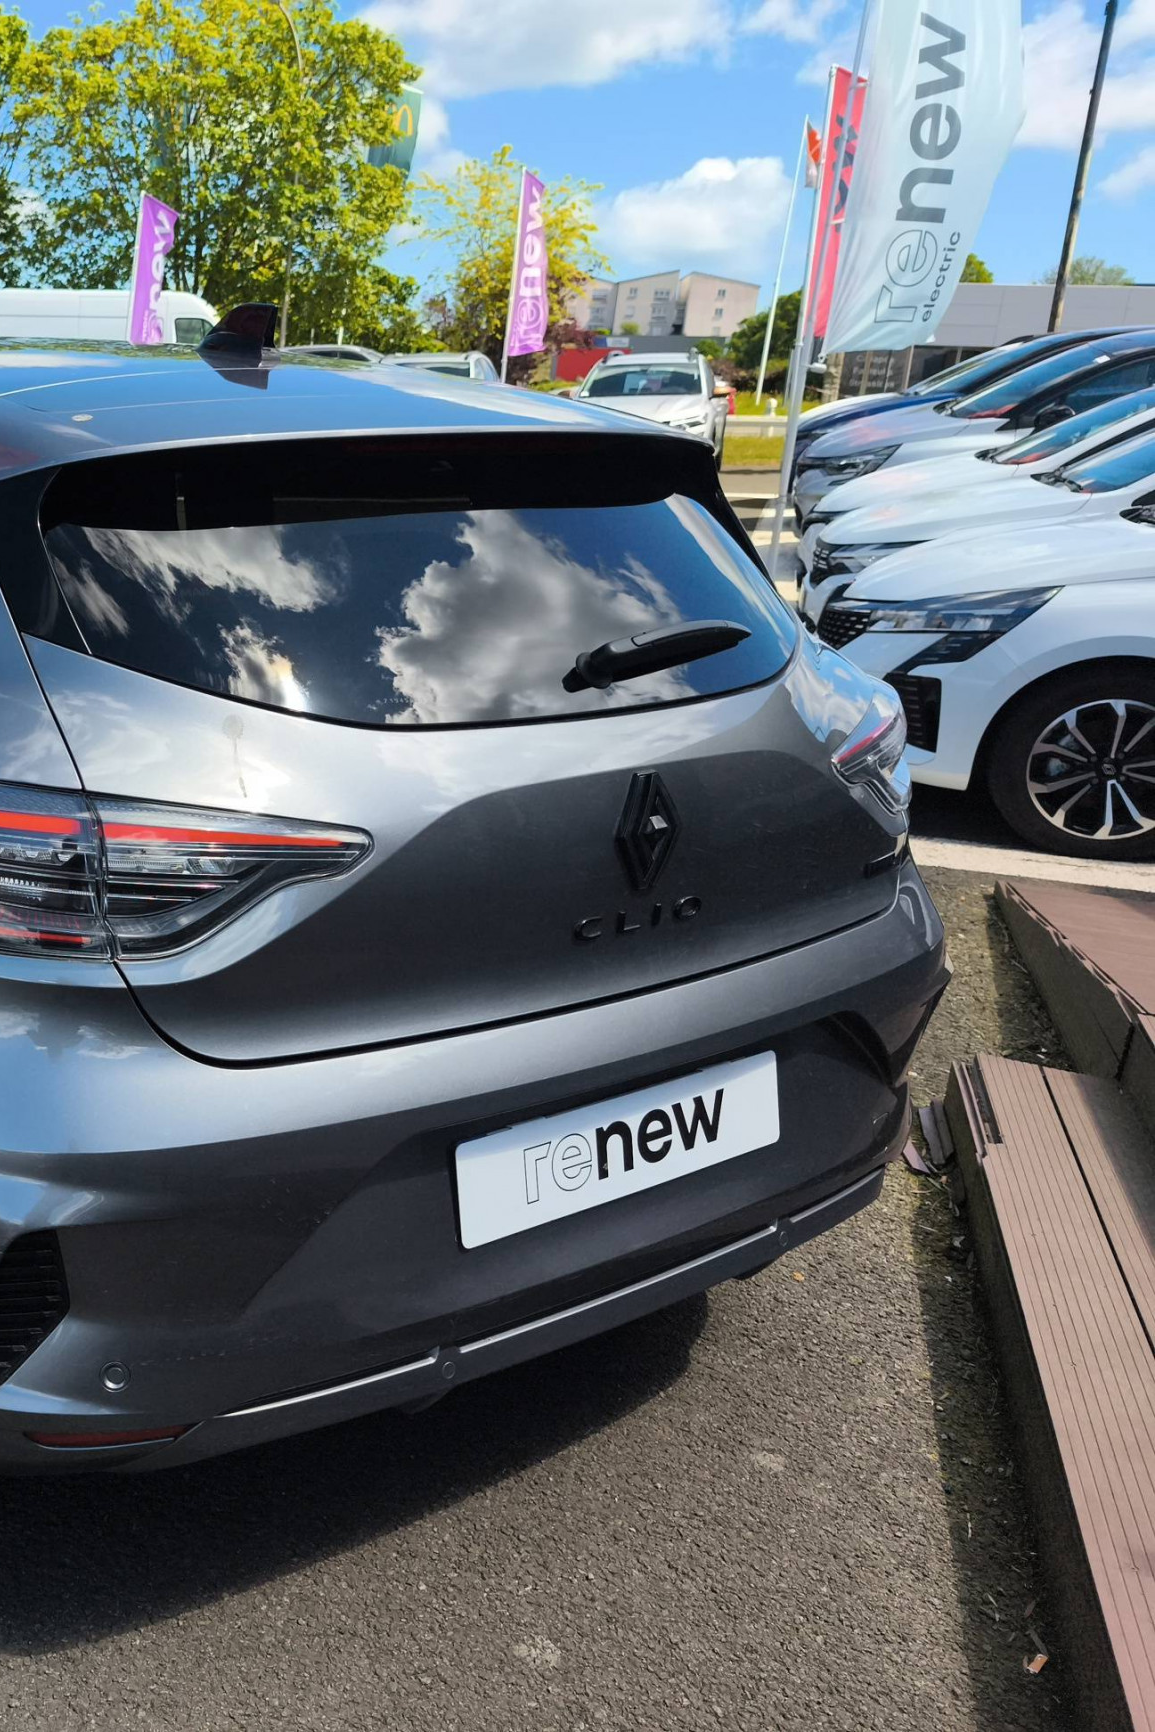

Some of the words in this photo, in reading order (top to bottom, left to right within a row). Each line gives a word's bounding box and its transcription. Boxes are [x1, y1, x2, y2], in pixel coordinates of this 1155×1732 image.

[874, 12, 966, 323] renew
[922, 231, 961, 322] electric
[573, 895, 703, 941] CLIO
[523, 1088, 725, 1205] renew
